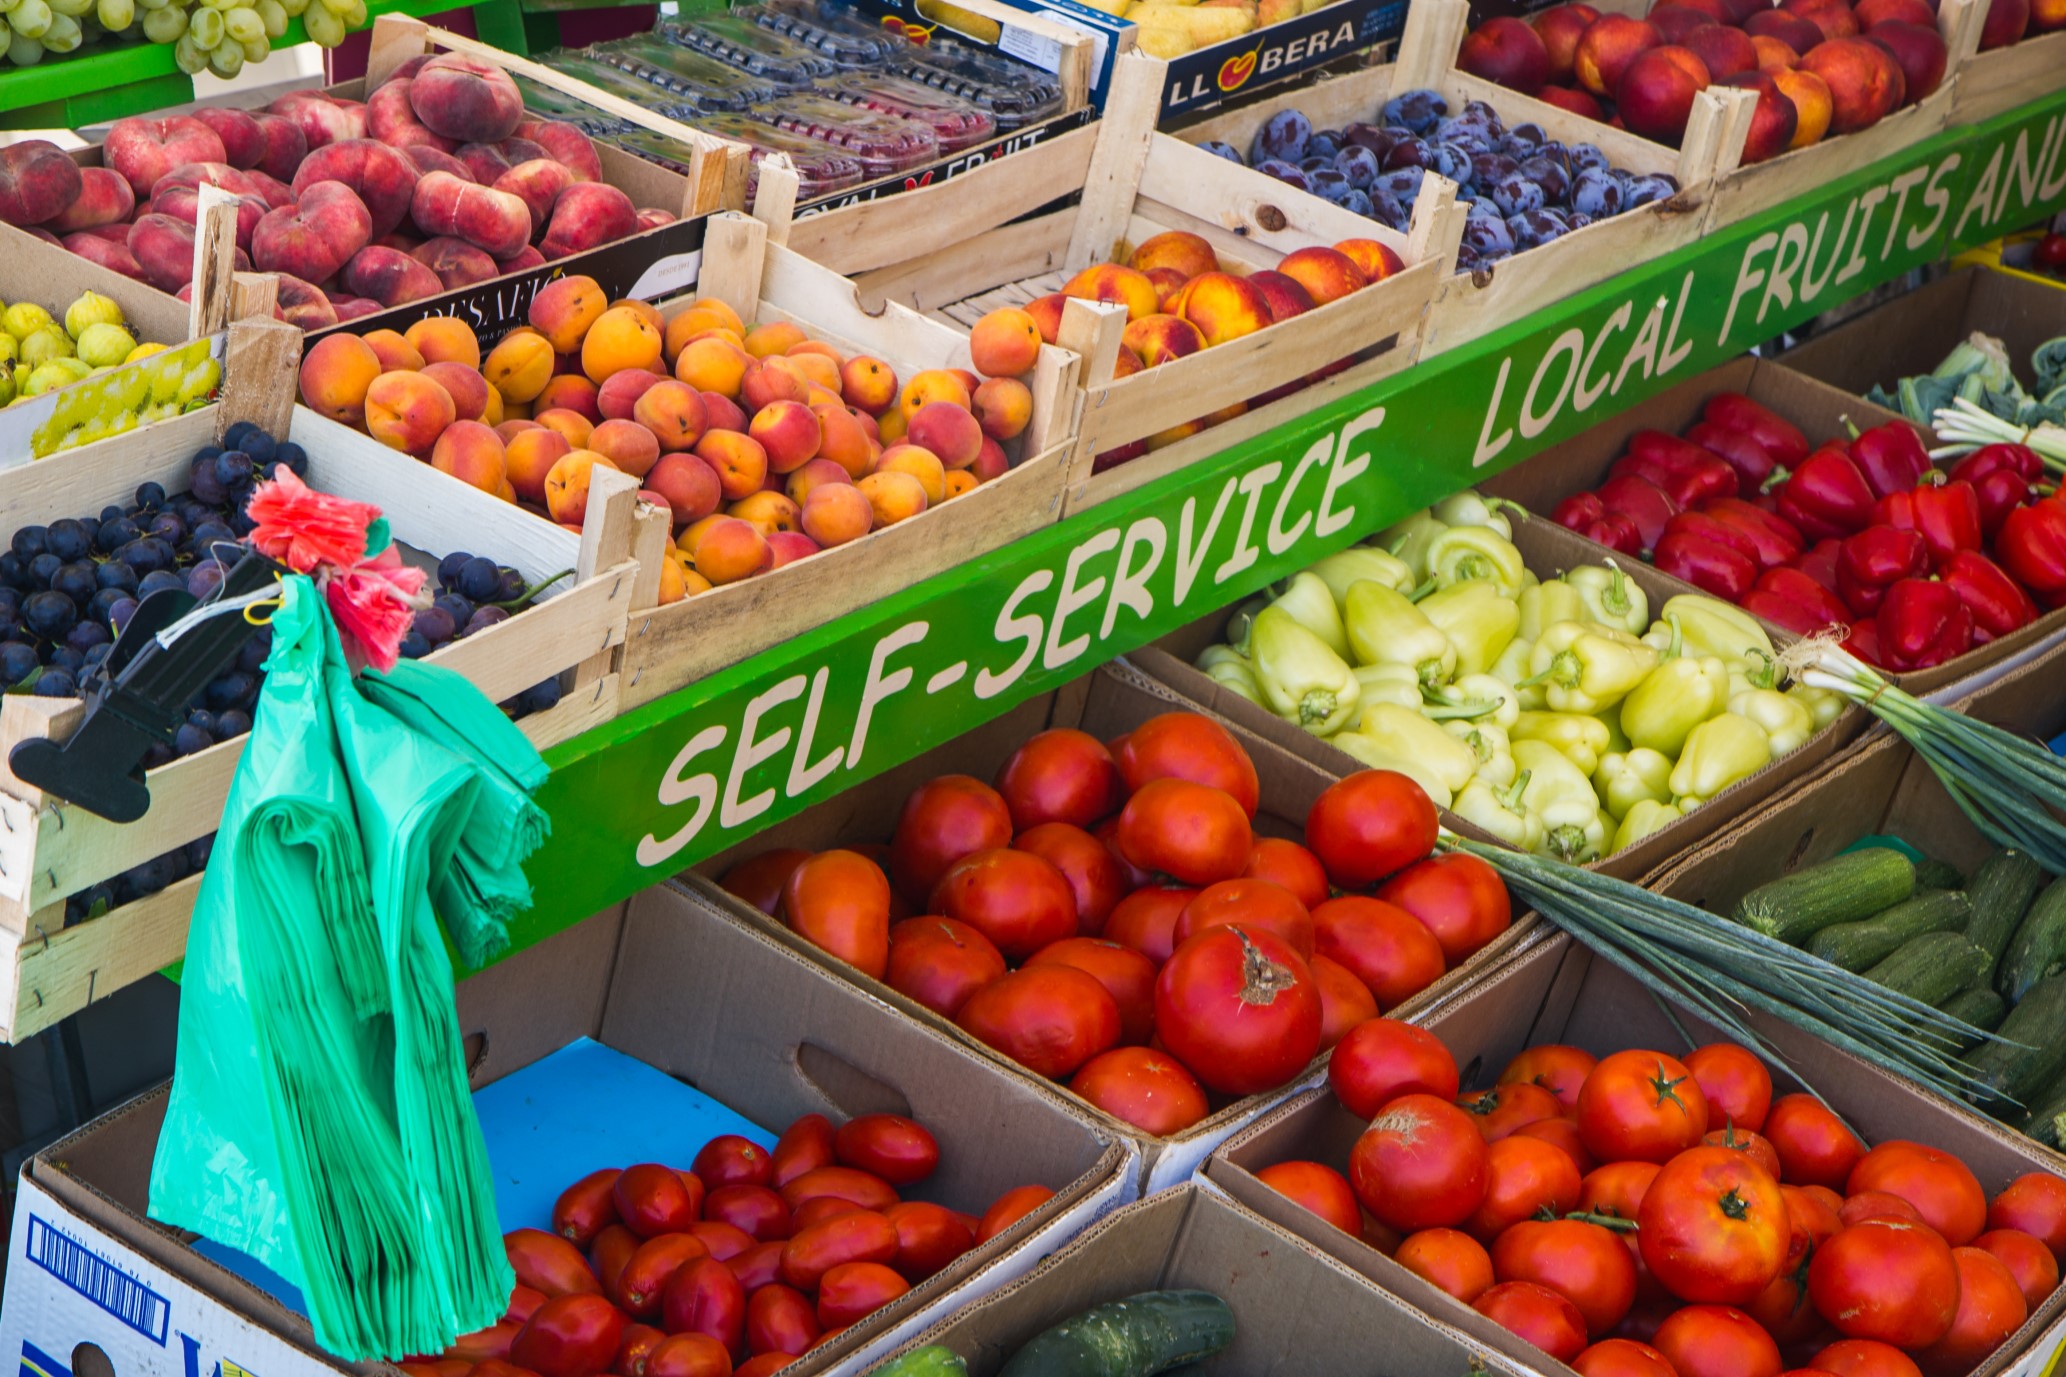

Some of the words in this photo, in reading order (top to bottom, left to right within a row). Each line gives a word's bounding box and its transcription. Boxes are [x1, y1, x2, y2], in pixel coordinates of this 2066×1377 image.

[1168, 73, 1210, 107] LL
[1259, 20, 1355, 74] BERA
[636, 407, 1386, 867] SELF-SERVICE
[1473, 272, 1693, 467] LOCAL
[1717, 152, 1962, 346] FRUITS
